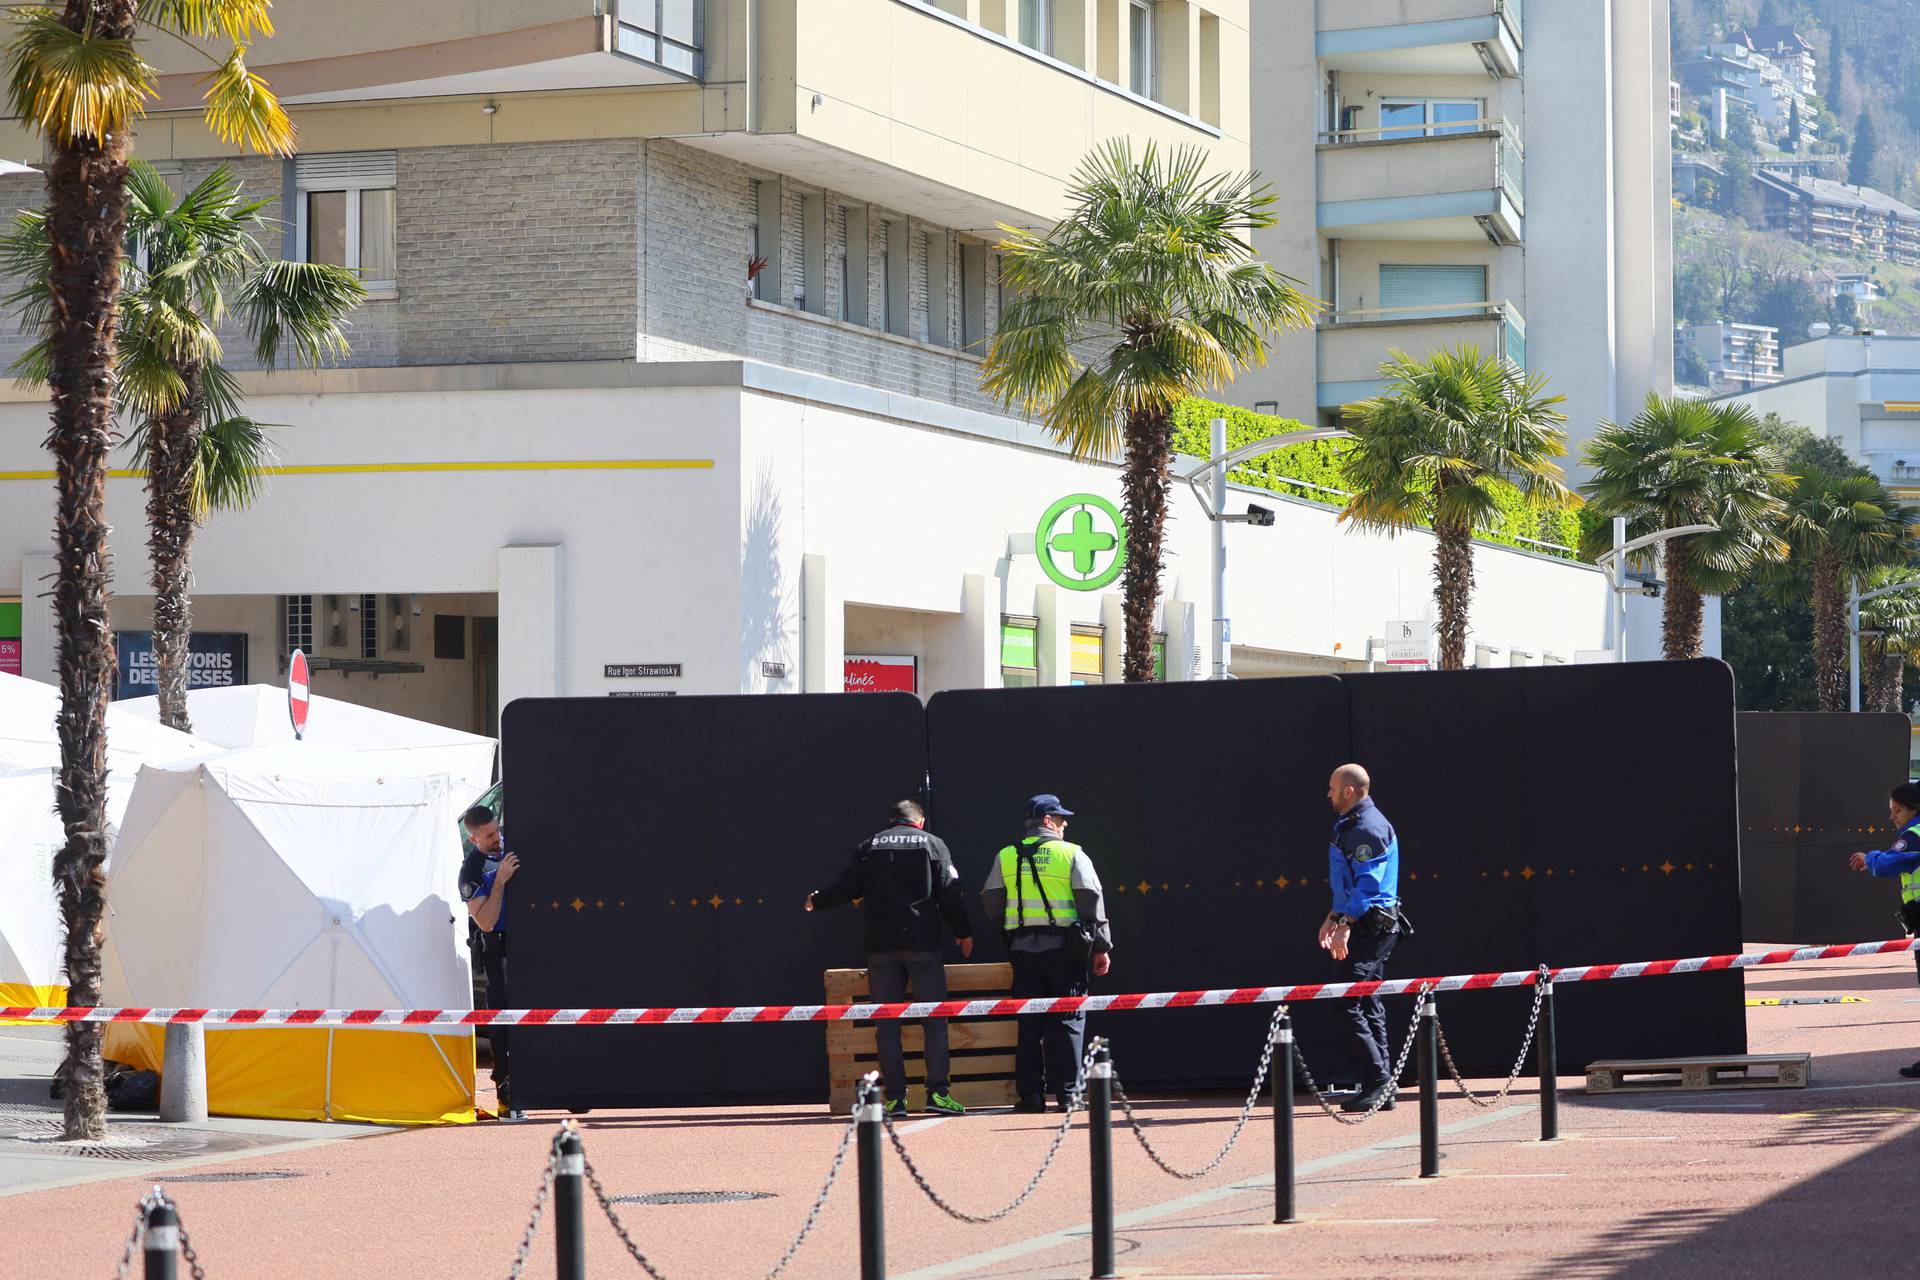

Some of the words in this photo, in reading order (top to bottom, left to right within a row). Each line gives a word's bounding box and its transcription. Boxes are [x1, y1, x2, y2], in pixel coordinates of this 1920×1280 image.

[129, 652, 157, 668] LES
[187, 653, 232, 668] VORIS
[129, 669, 159, 684] DES
[187, 669, 233, 686] ISSES
[608, 667, 621, 676] Rue
[622, 666, 636, 678] Igor
[638, 666, 678, 677] Strawinsky
[872, 835, 928, 846] SOUTIEN
